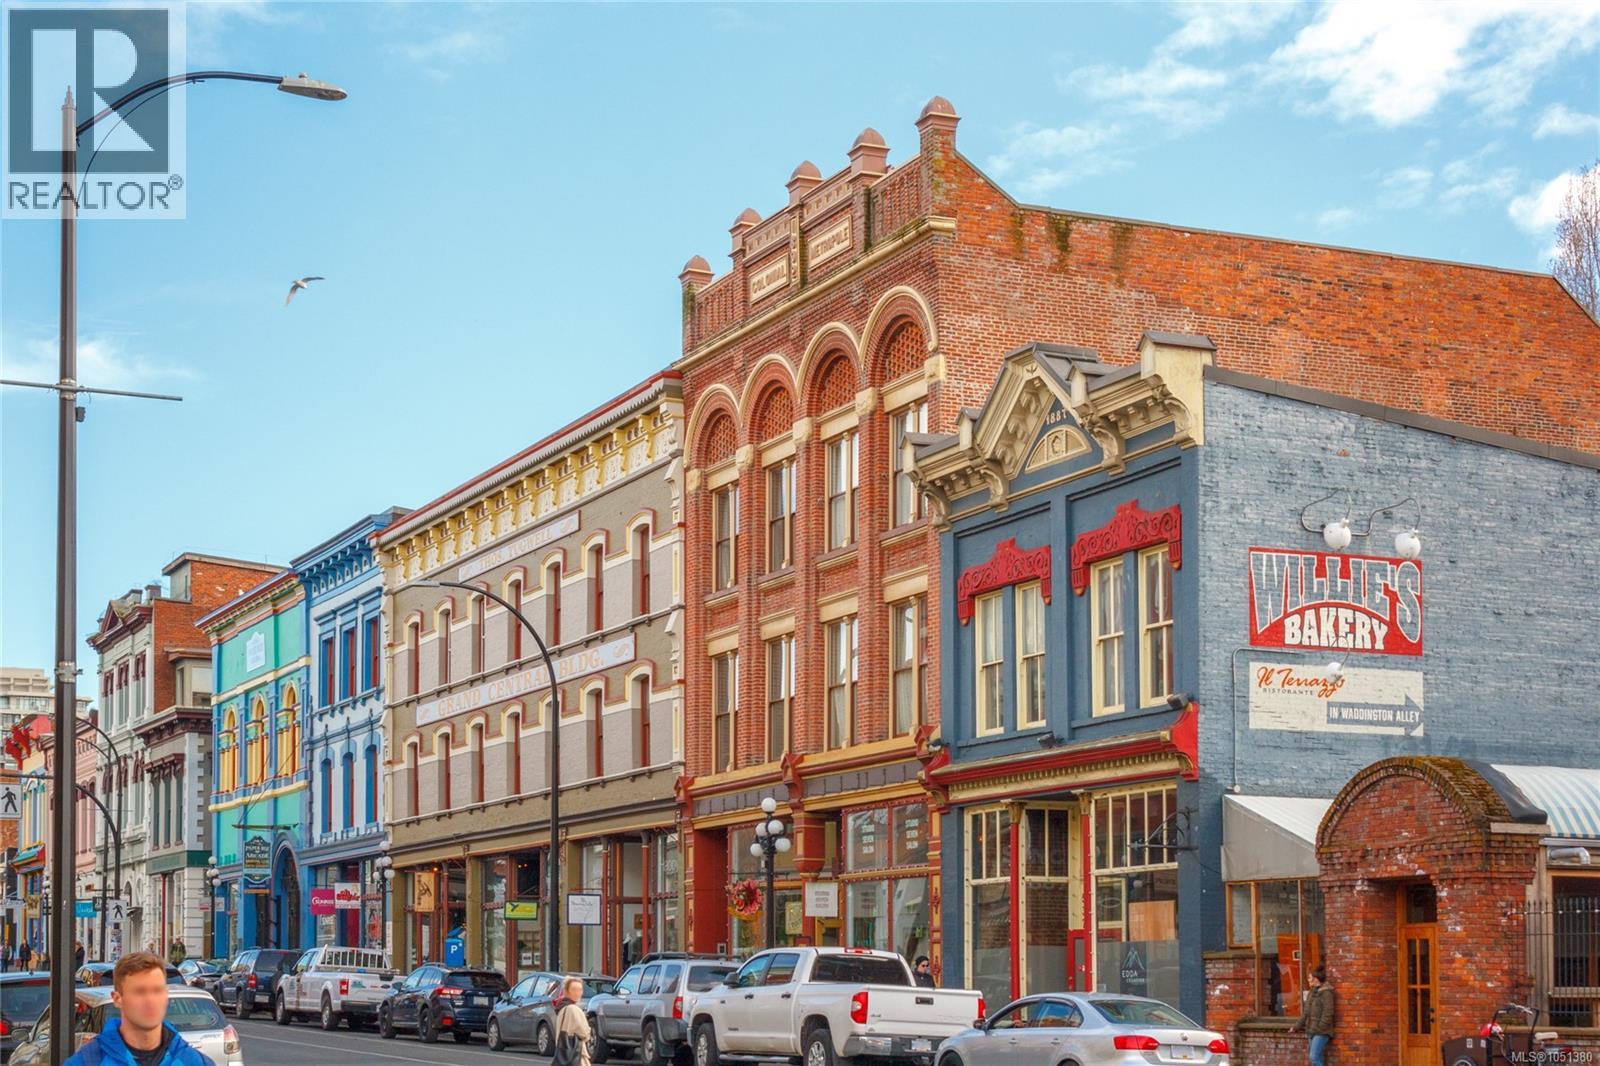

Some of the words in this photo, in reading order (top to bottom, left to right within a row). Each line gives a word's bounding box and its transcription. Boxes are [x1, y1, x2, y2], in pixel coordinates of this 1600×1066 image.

[1045, 408, 1067, 425] 1887
[1249, 551, 1422, 645] WILLIE'S
[1284, 607, 1389, 650] BAKERY
[438, 688, 481, 716] GRAND
[559, 649, 604, 679] BLDG.
[1256, 666, 1273, 687] Il
[1262, 687, 1314, 696] RISTORANTE
[1329, 706, 1340, 718] IN
[1341, 707, 1393, 722] WADDINGTON
[1395, 709, 1420, 723] ALLEY
[450, 945, 458, 954] P
